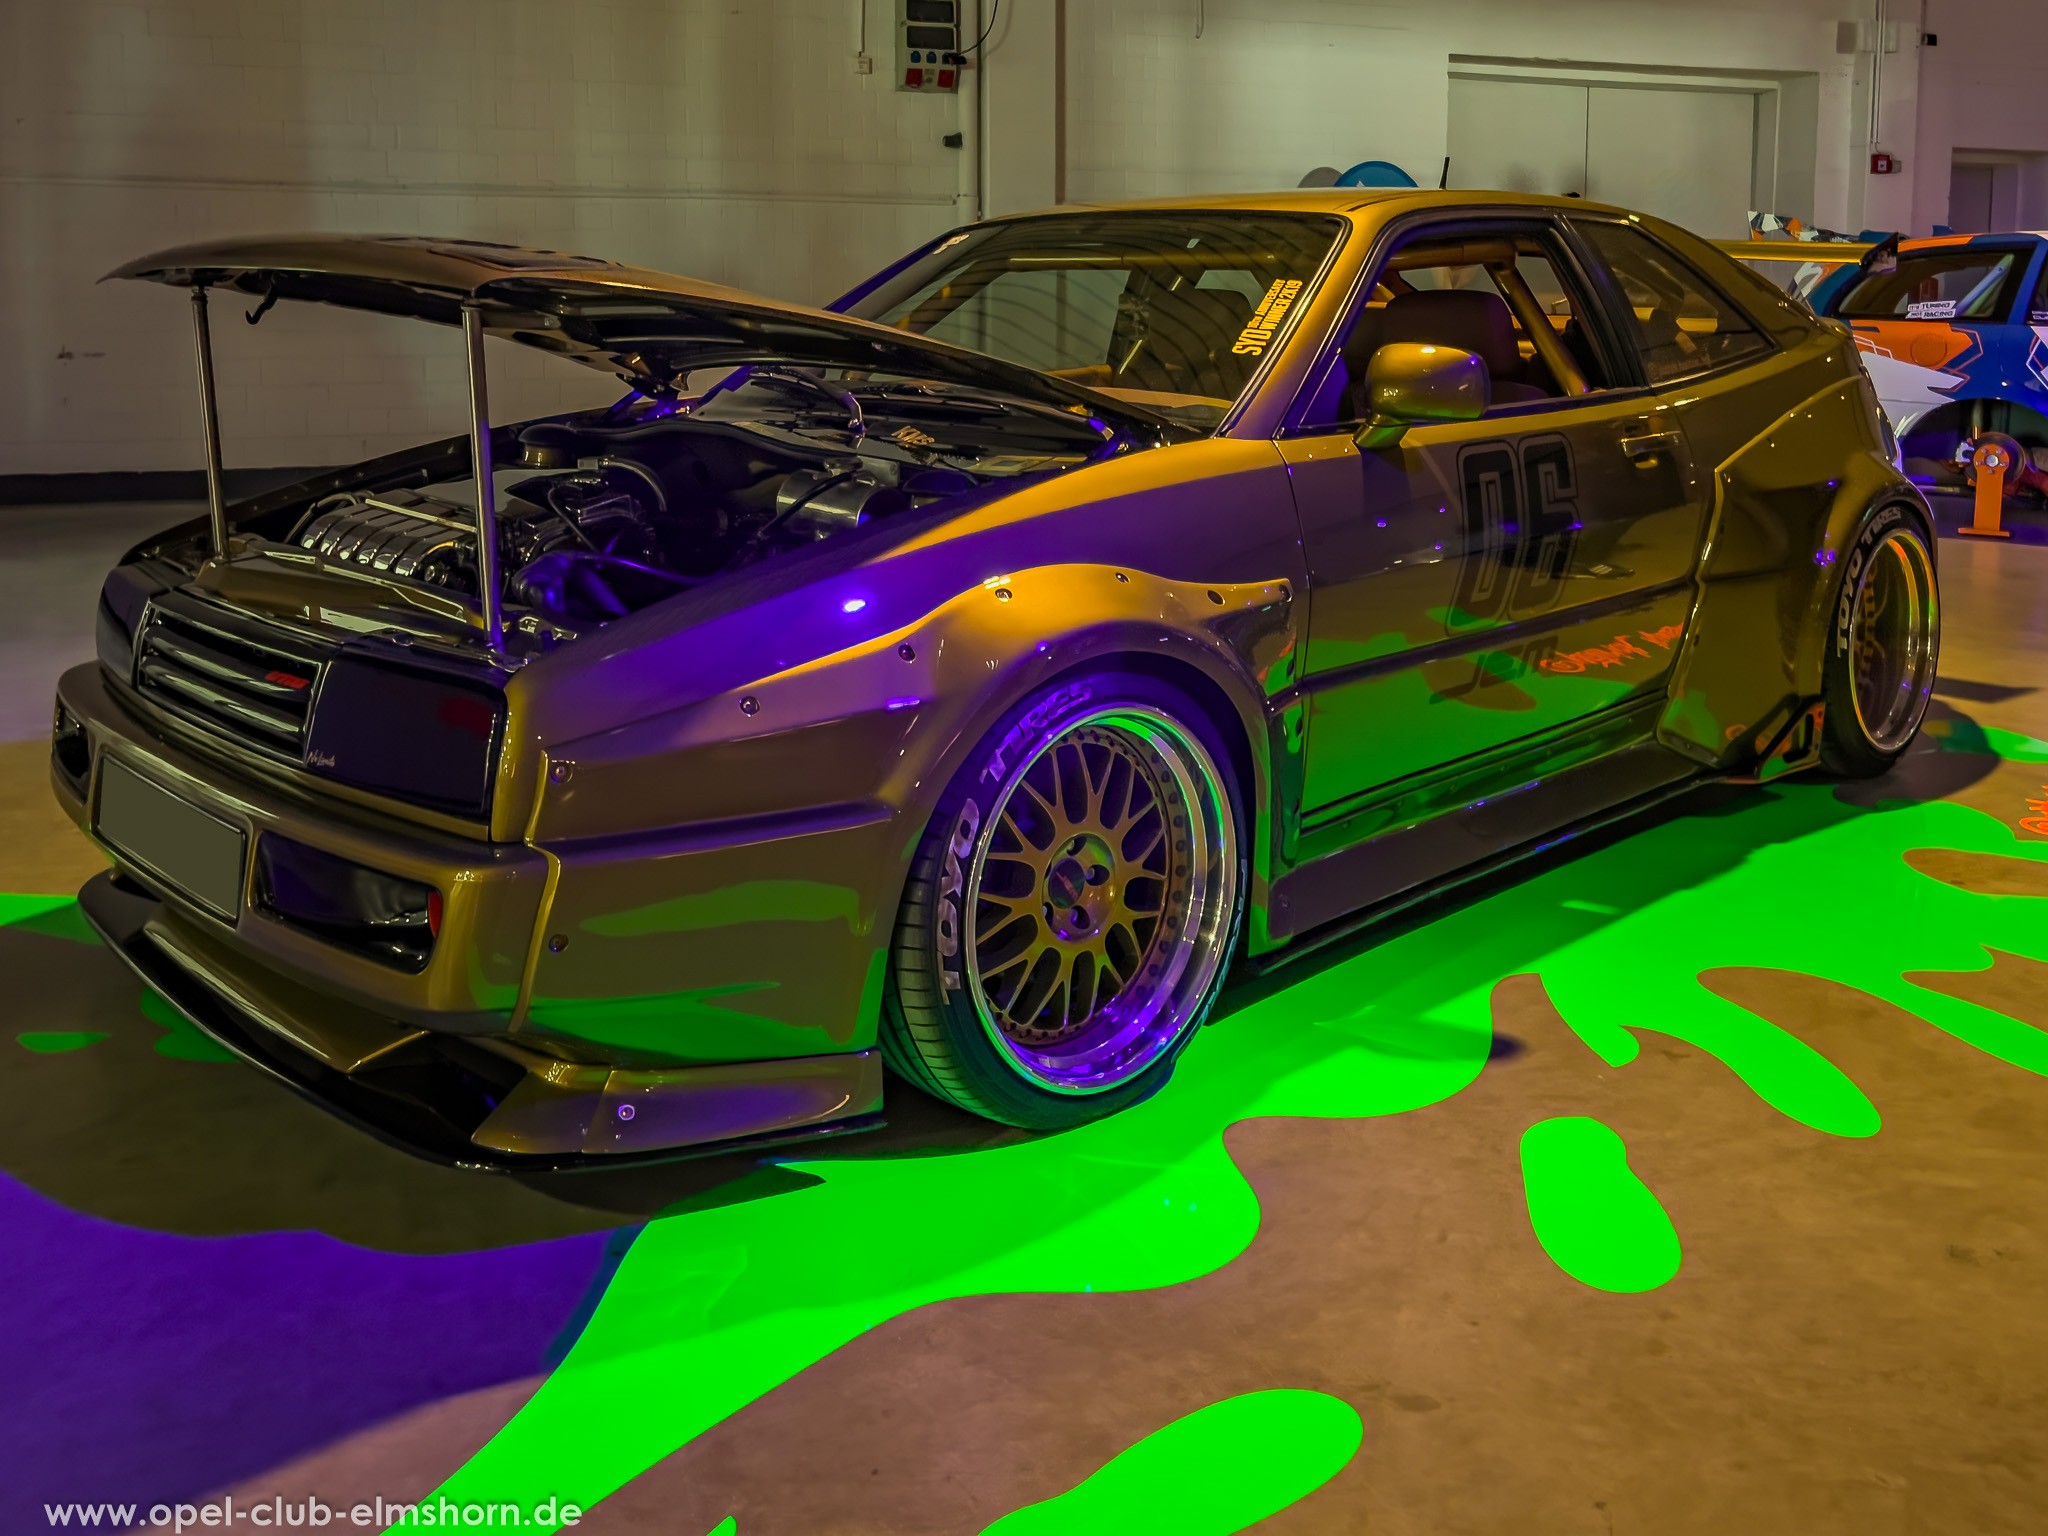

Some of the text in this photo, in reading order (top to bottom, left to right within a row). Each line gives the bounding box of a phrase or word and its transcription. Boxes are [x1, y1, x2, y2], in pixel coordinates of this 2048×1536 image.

[1231, 328, 1273, 356] SYD
[1259, 280, 1303, 330] WINNER 2K19
[1445, 431, 1581, 637] 06
[1836, 506, 1902, 658] TOYO TIRES
[936, 683, 1094, 1005] TOYO TIRES
